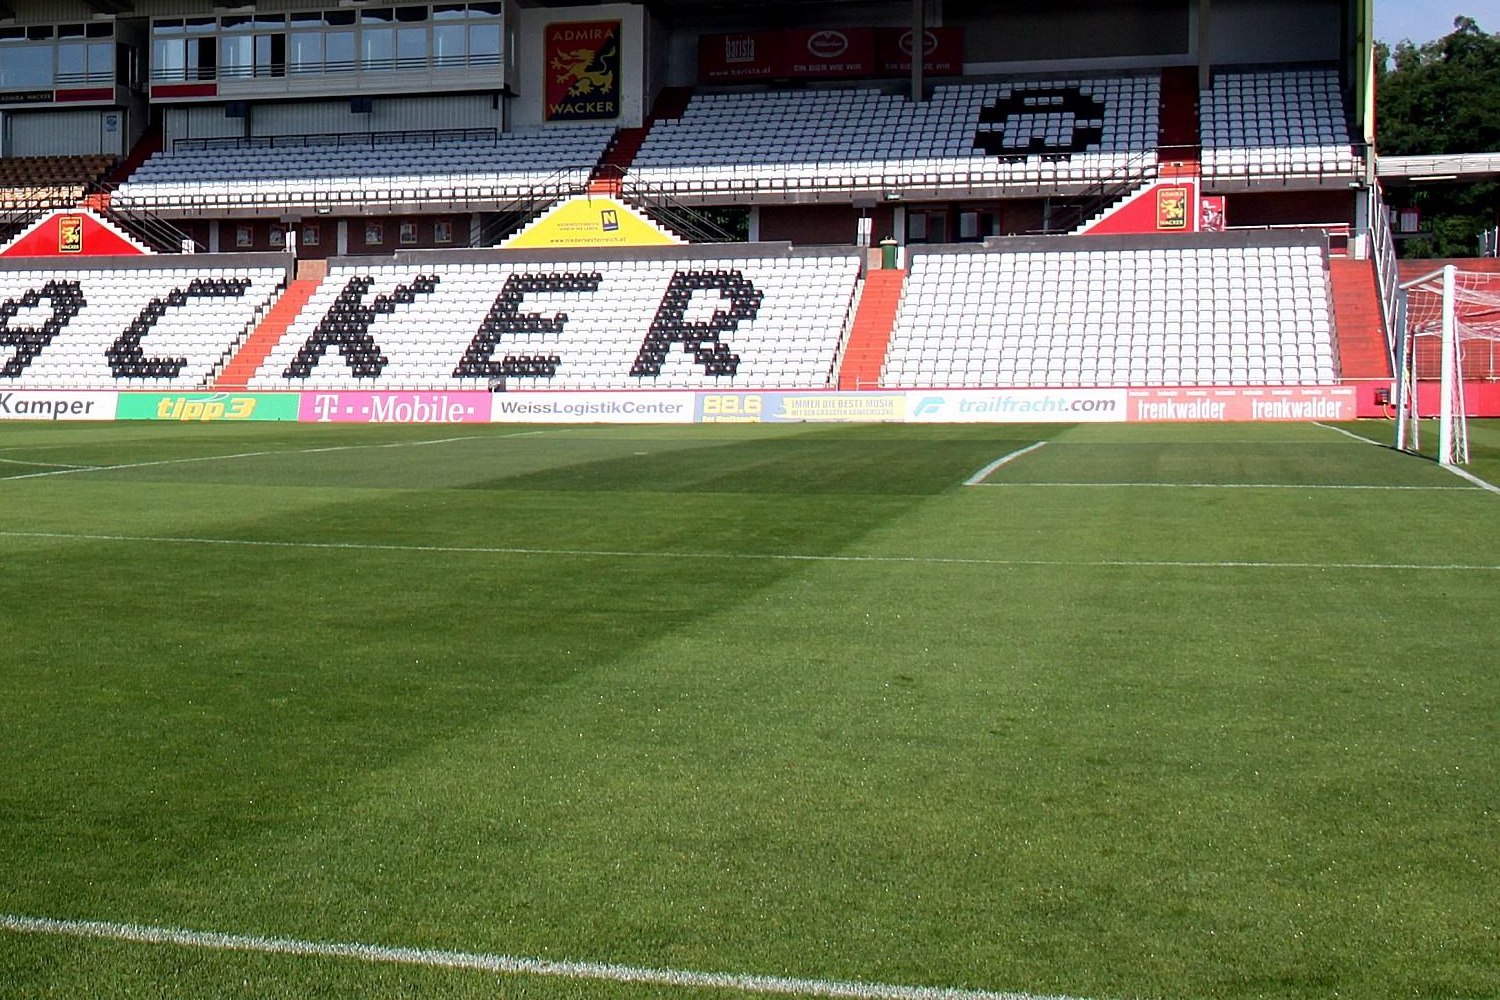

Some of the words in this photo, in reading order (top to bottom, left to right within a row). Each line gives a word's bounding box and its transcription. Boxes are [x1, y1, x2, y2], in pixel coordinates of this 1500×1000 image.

[552, 29, 615, 41] ADMIRA
[726, 35, 755, 58] barista
[549, 101, 614, 114] WACKER
[156, 396, 257, 422] tipp3
[501, 399, 684, 417] WeissLogistikCenter
[703, 395, 762, 414] 88.6
[791, 399, 821, 409] IMMER
[823, 399, 836, 409] DIE
[838, 399, 861, 409] BESTE
[865, 399, 895, 408] MUSIK
[958, 395, 1116, 414] trailfracht.com
[1137, 397, 1226, 420] trenkwalder
[1251, 397, 1342, 420] trenkwalder
